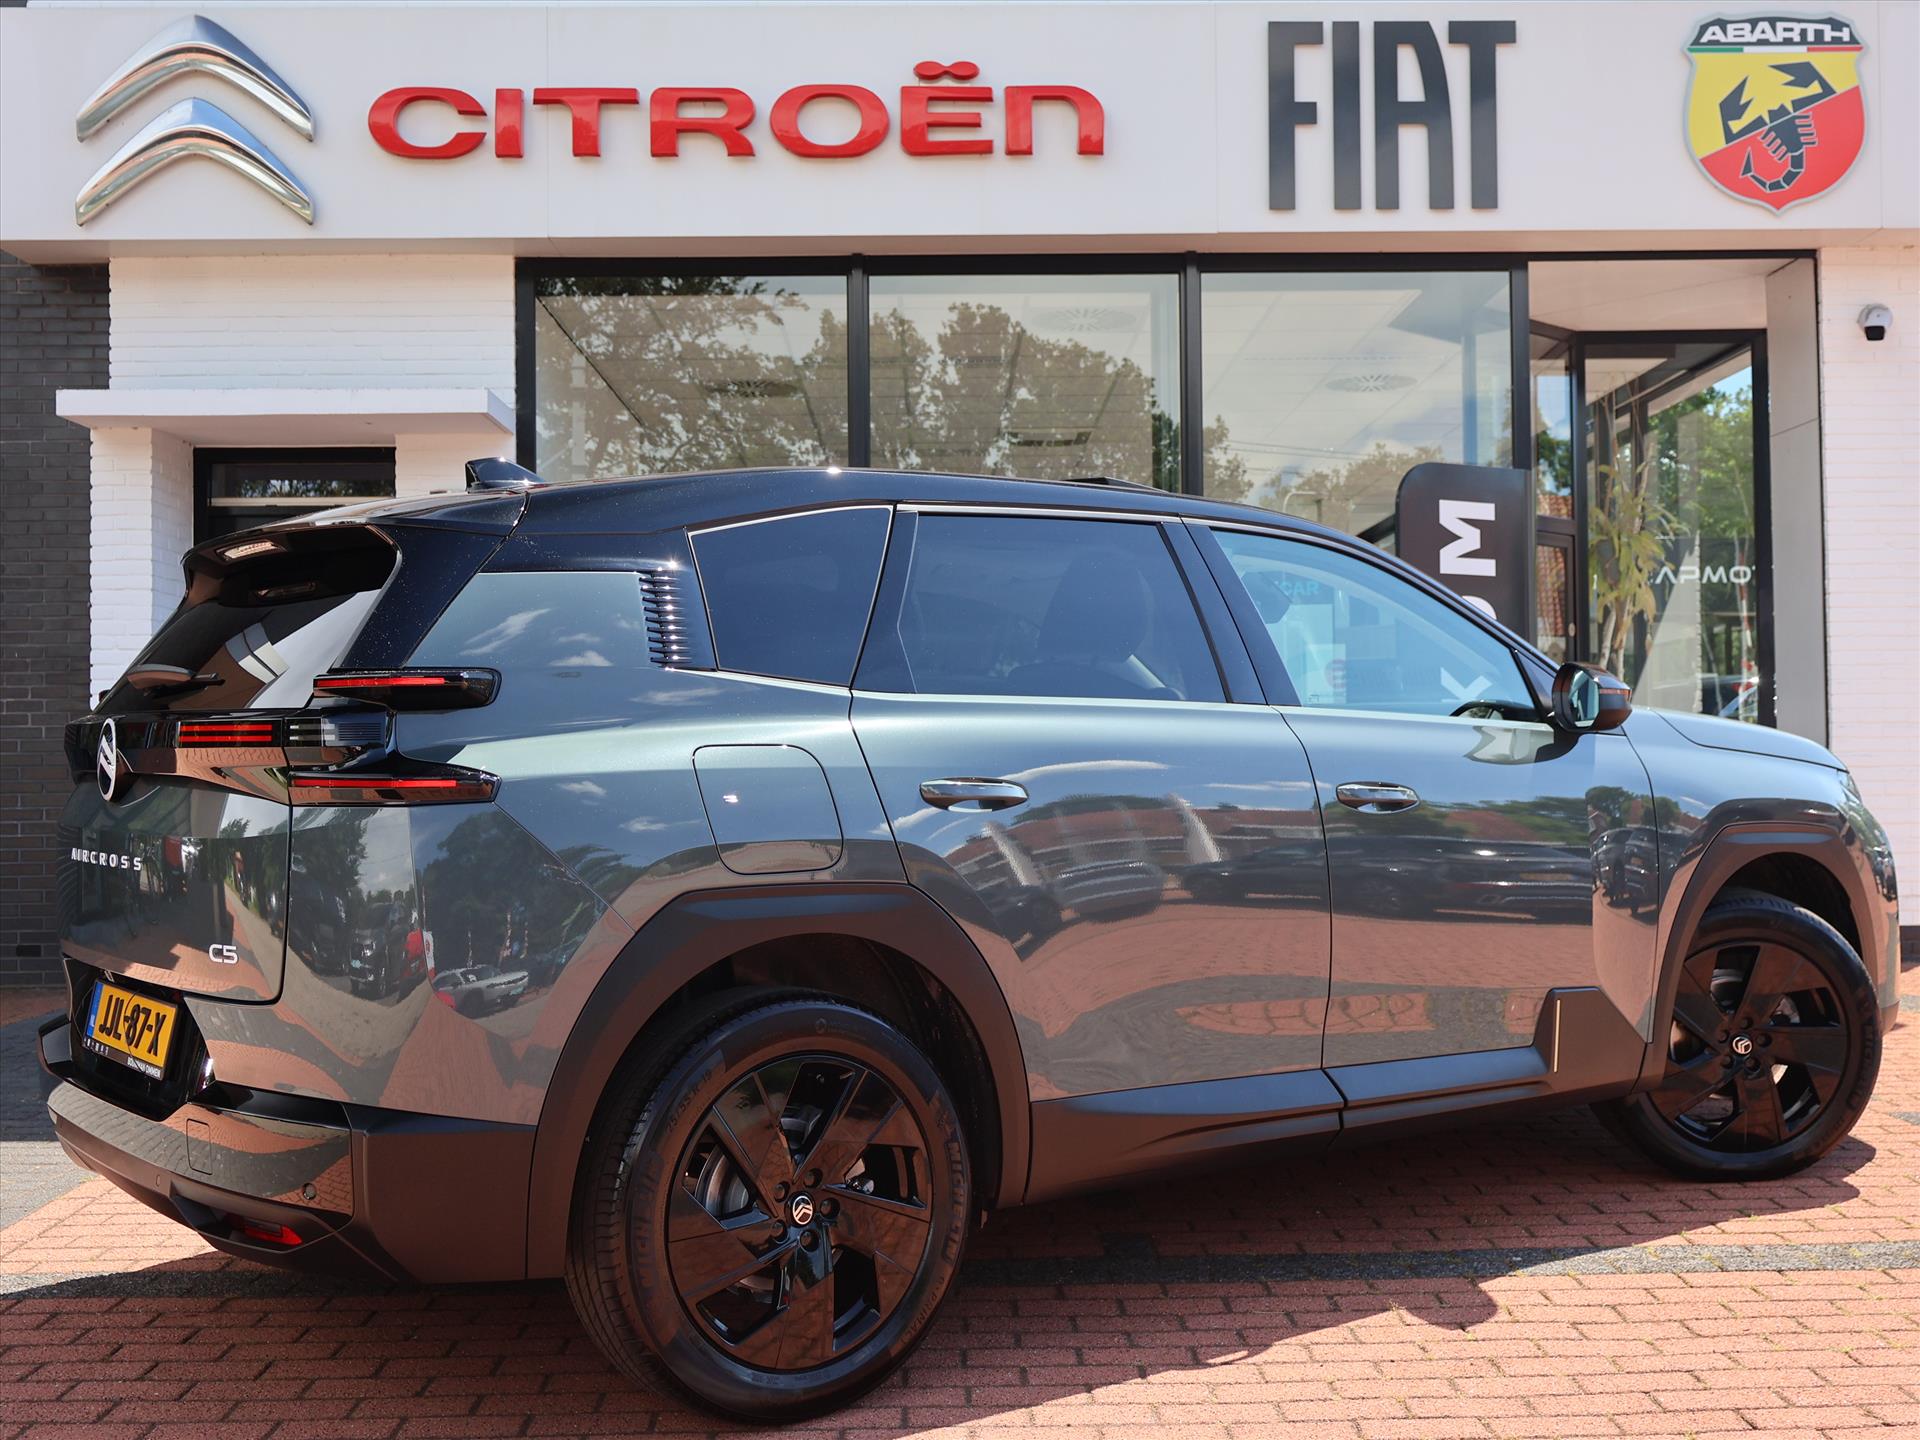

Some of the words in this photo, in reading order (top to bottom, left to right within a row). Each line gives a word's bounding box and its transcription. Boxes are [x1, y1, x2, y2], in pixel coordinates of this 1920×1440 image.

[1700, 21, 1850, 43] ABARTH
[1268, 20, 1516, 210] FIAT
[71, 847, 144, 871] AIRCROSS
[209, 944, 239, 964] C5
[98, 994, 167, 1057] JJL-87-X
